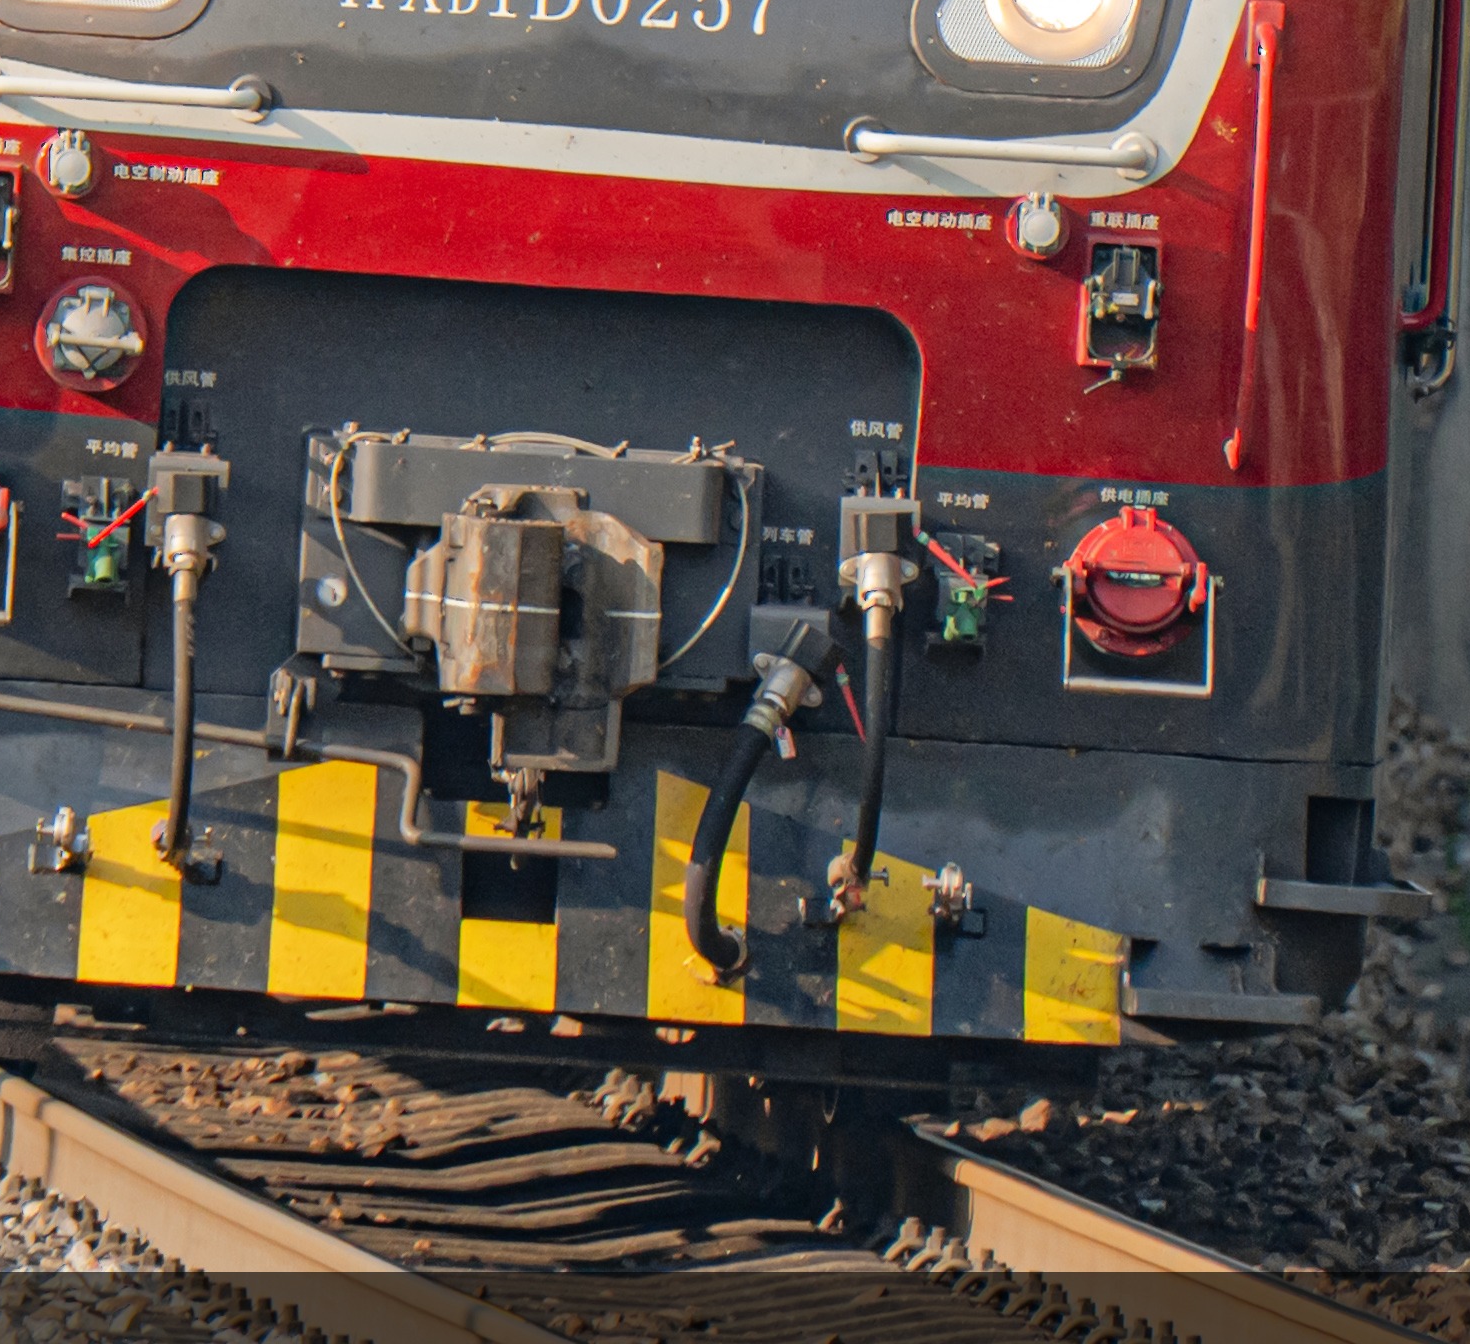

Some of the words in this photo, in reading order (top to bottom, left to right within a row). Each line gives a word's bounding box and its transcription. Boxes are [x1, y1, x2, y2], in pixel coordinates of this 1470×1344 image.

[1089, 210, 1160, 232] 重联插座
[850, 419, 904, 441] 供风管
[85, 438, 139, 459] 平均管
[936, 490, 990, 511] 平均管
[1100, 486, 1170, 507] 供电插座
[762, 525, 815, 546] 列车管
